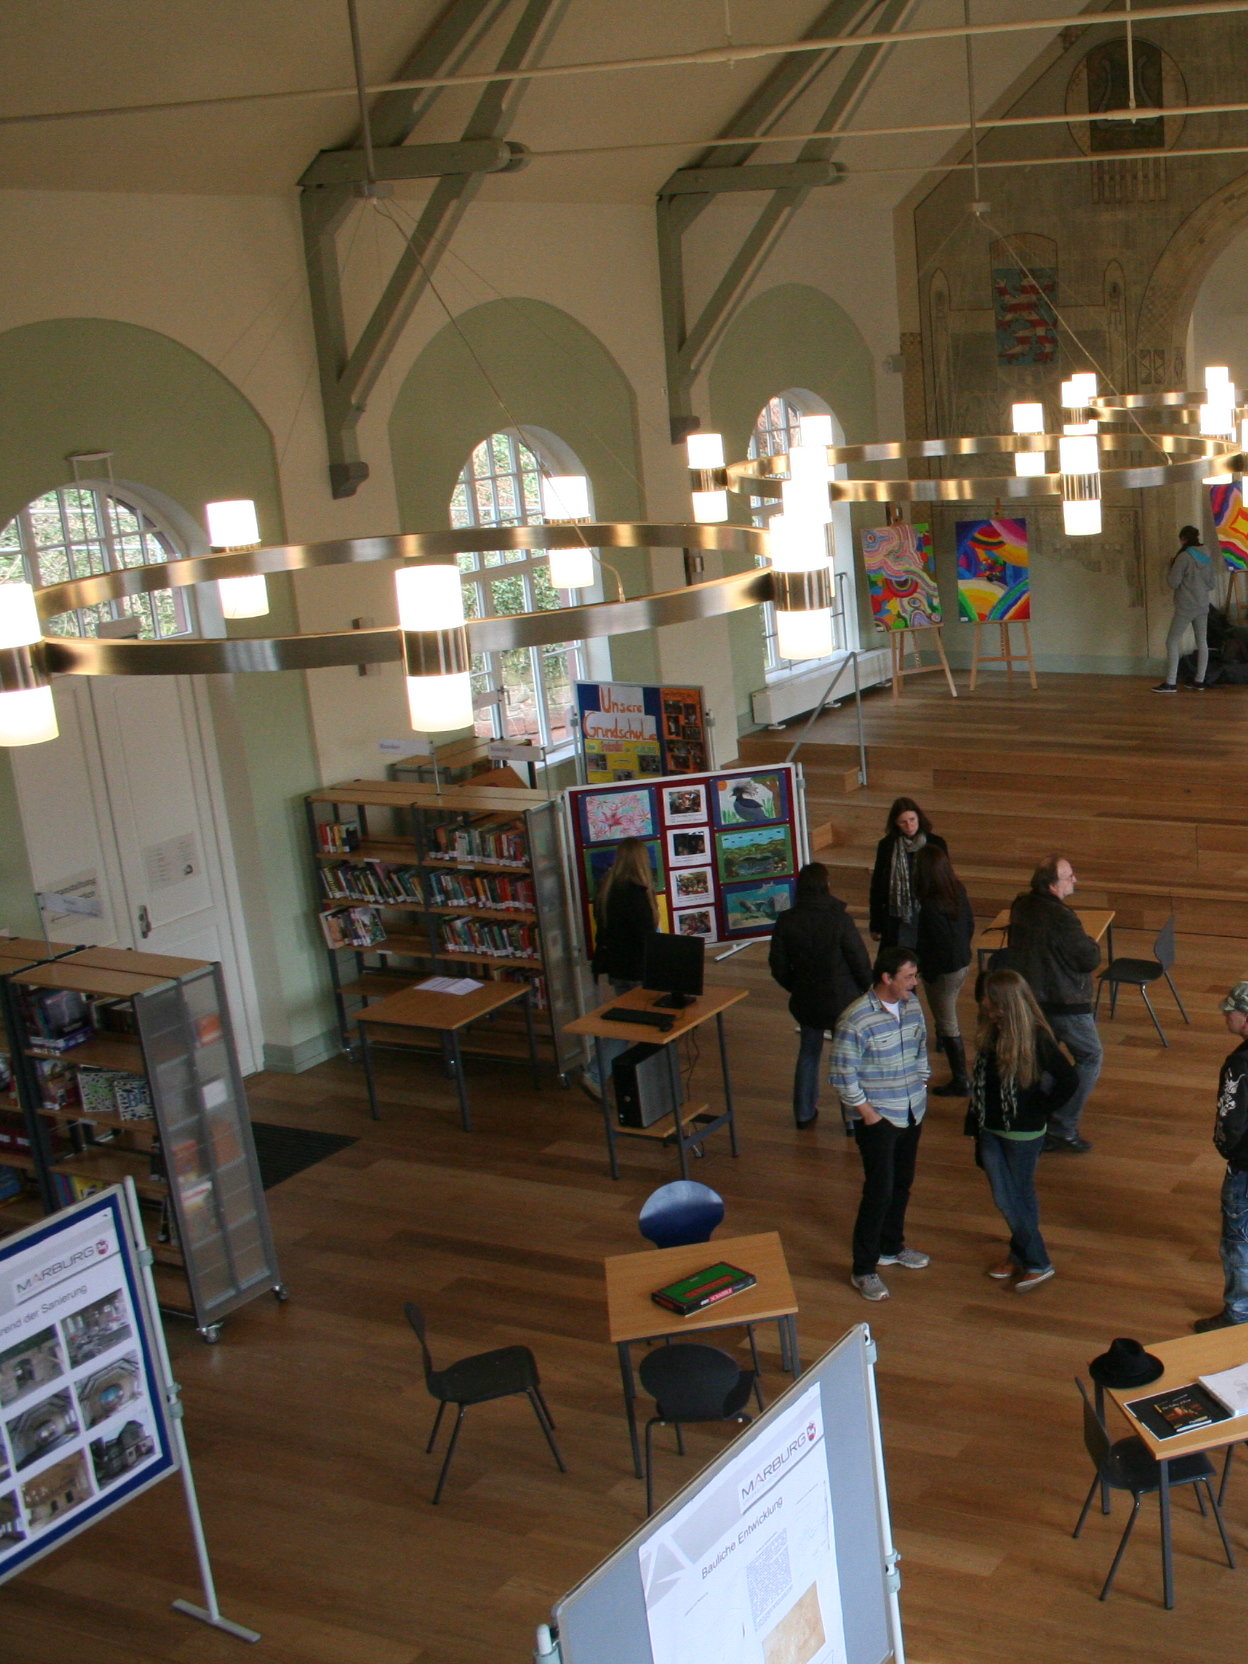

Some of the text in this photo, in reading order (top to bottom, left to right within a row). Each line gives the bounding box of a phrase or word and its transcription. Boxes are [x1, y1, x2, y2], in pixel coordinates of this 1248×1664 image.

[601, 686, 643, 713] Unsere
[16, 1245, 95, 1294] MARBURG
[24, 1309, 40, 1324] der
[41, 1284, 88, 1314] Sanierung
[741, 1433, 807, 1500] MARBURG
[701, 1541, 736, 1580] Bauliche
[737, 1496, 784, 1545] Entwicklung
